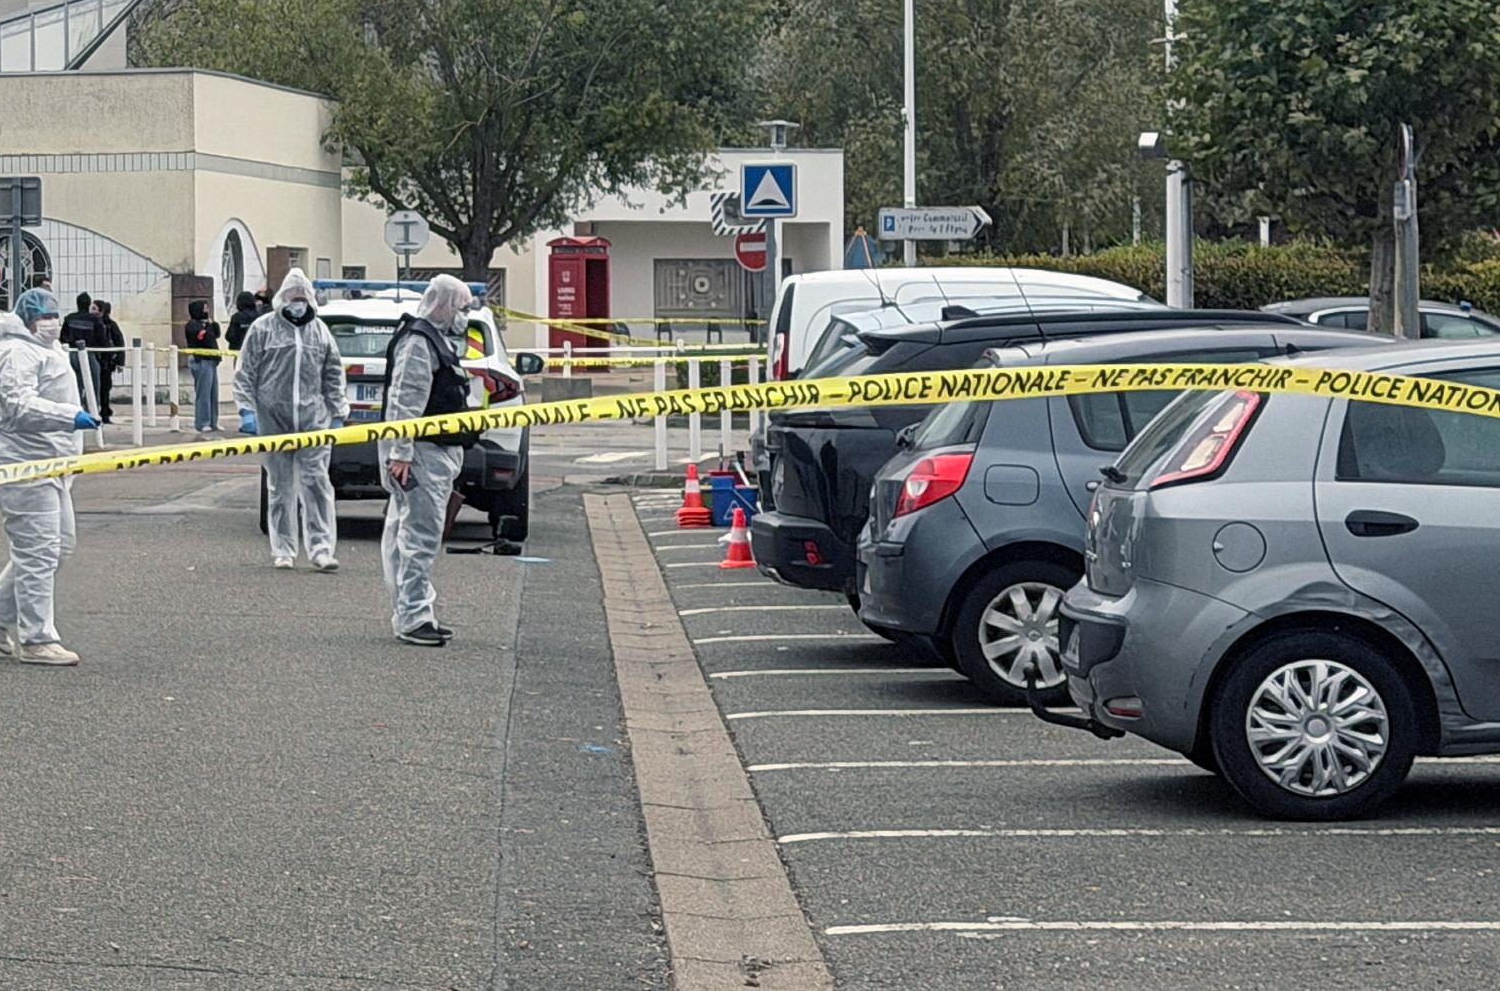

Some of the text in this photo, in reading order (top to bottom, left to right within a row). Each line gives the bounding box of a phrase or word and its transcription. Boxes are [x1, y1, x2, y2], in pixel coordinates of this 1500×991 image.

[355, 325, 395, 334] BRIGAD
[457, 403, 591, 434] NATIONALE
[655, 393, 697, 416] PAS
[700, 383, 820, 414] FRANCHIR
[847, 376, 933, 403] POLICE
[937, 369, 1072, 398] NATIONALE
[1091, 367, 1131, 388] NE
[1128, 367, 1173, 387] PAS
[1172, 367, 1292, 389] FRANCHIR
[1314, 373, 1407, 400] POLICE
